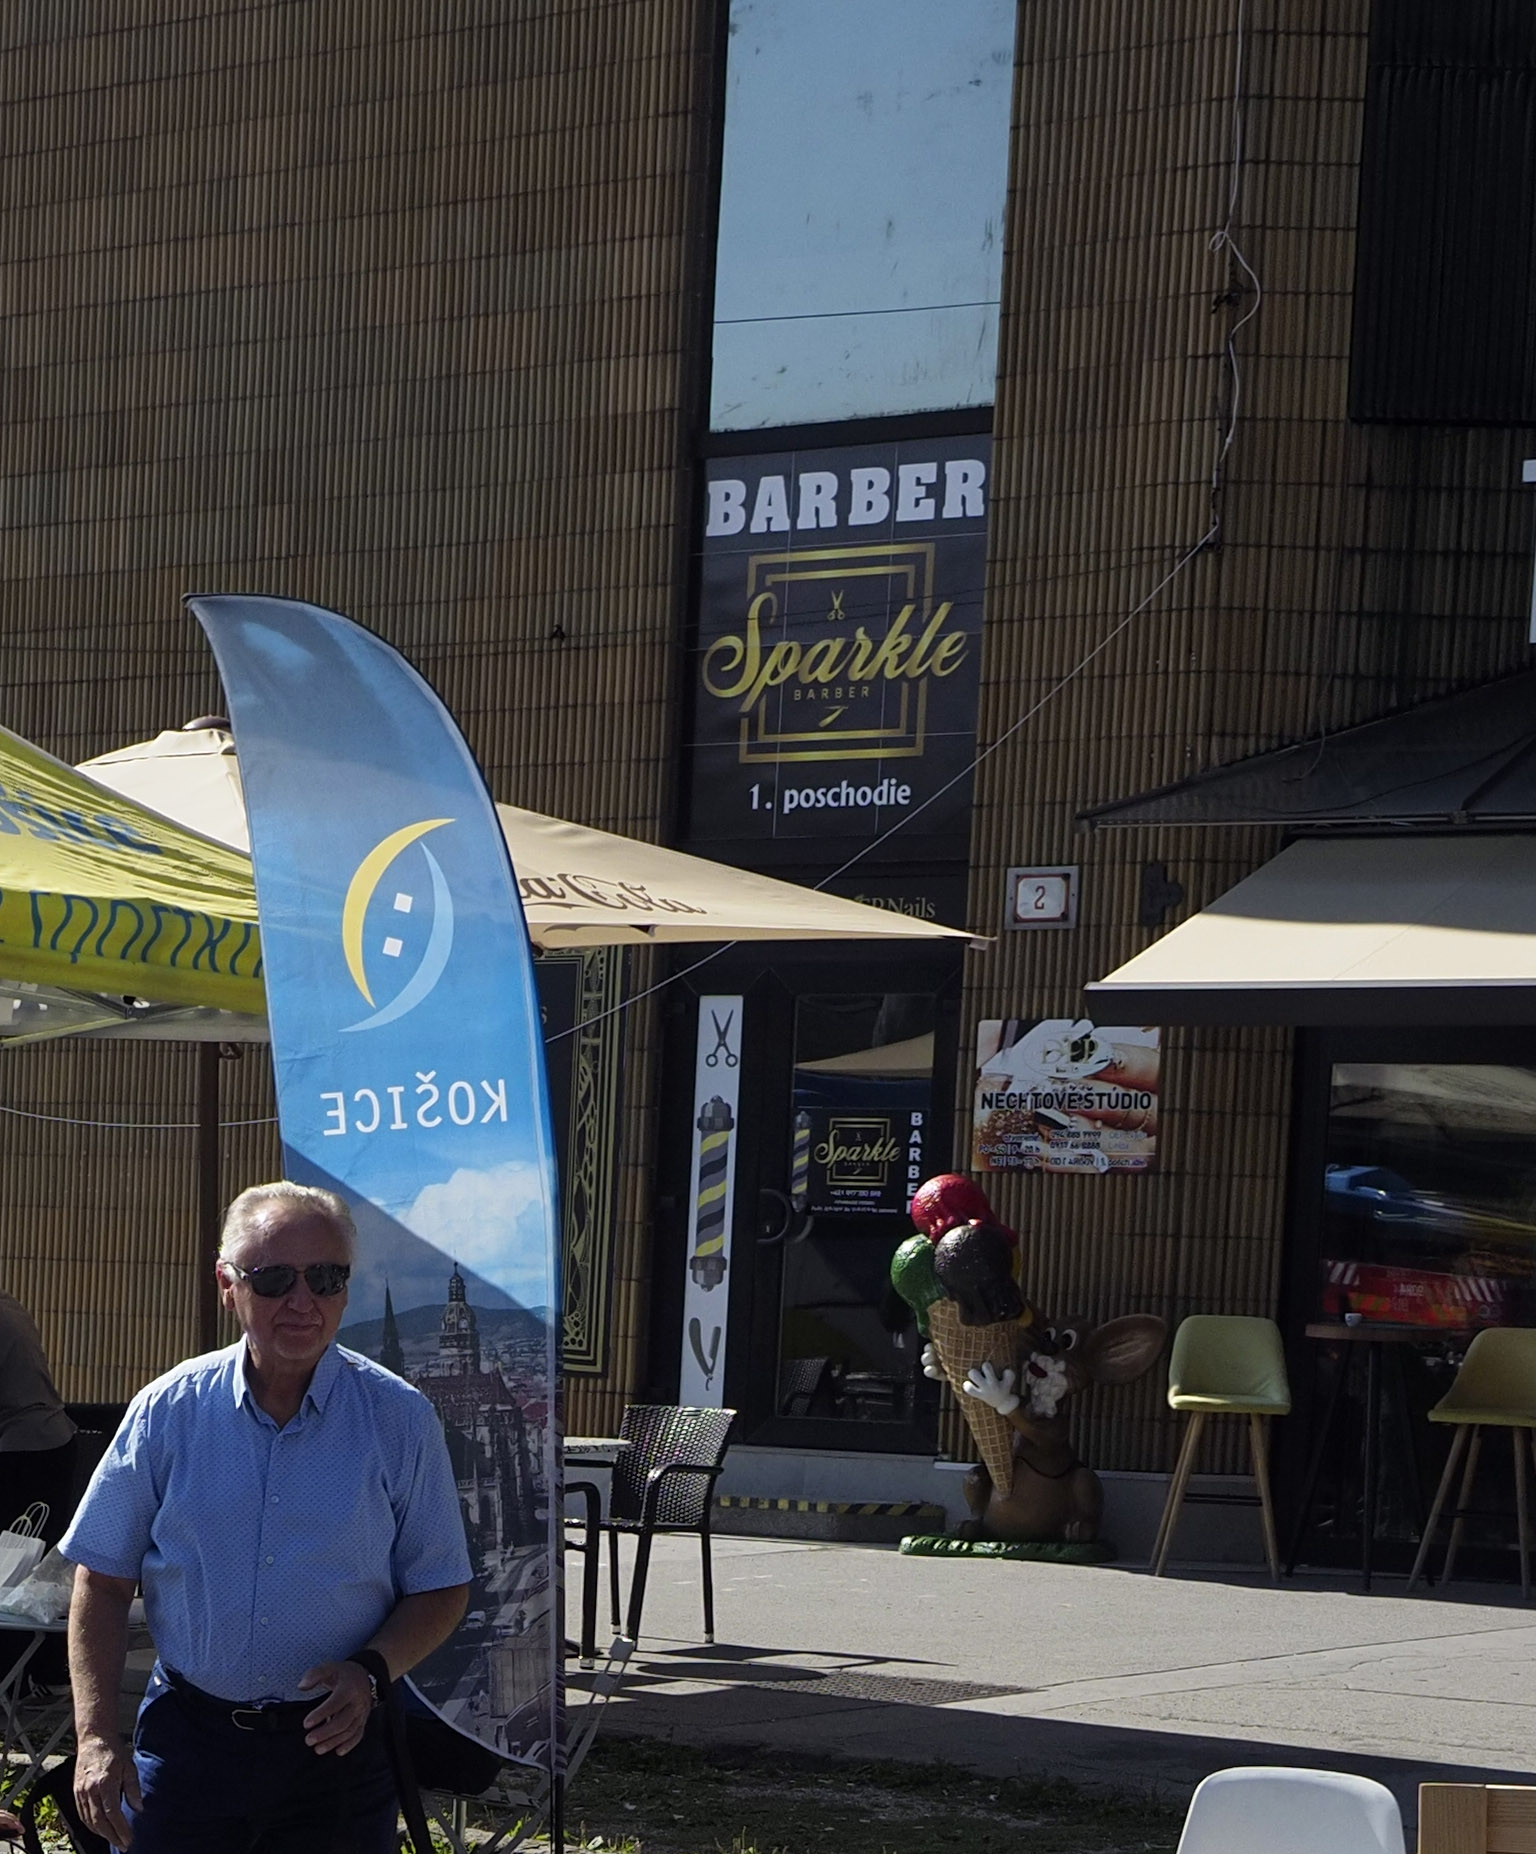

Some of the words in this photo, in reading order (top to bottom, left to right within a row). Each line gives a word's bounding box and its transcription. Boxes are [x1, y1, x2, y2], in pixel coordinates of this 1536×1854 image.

[703, 458, 986, 538] BARBER
[701, 588, 972, 713] Sparkle
[792, 685, 871, 702] BARBER
[747, 782, 773, 812] 1.
[782, 776, 913, 816] poschodie
[1034, 884, 1046, 910] 2
[980, 1085, 1078, 1111] NECHTOVÉ
[1083, 1085, 1153, 1111] ŠTÚDIO
[813, 1128, 902, 1169] Sparkle
